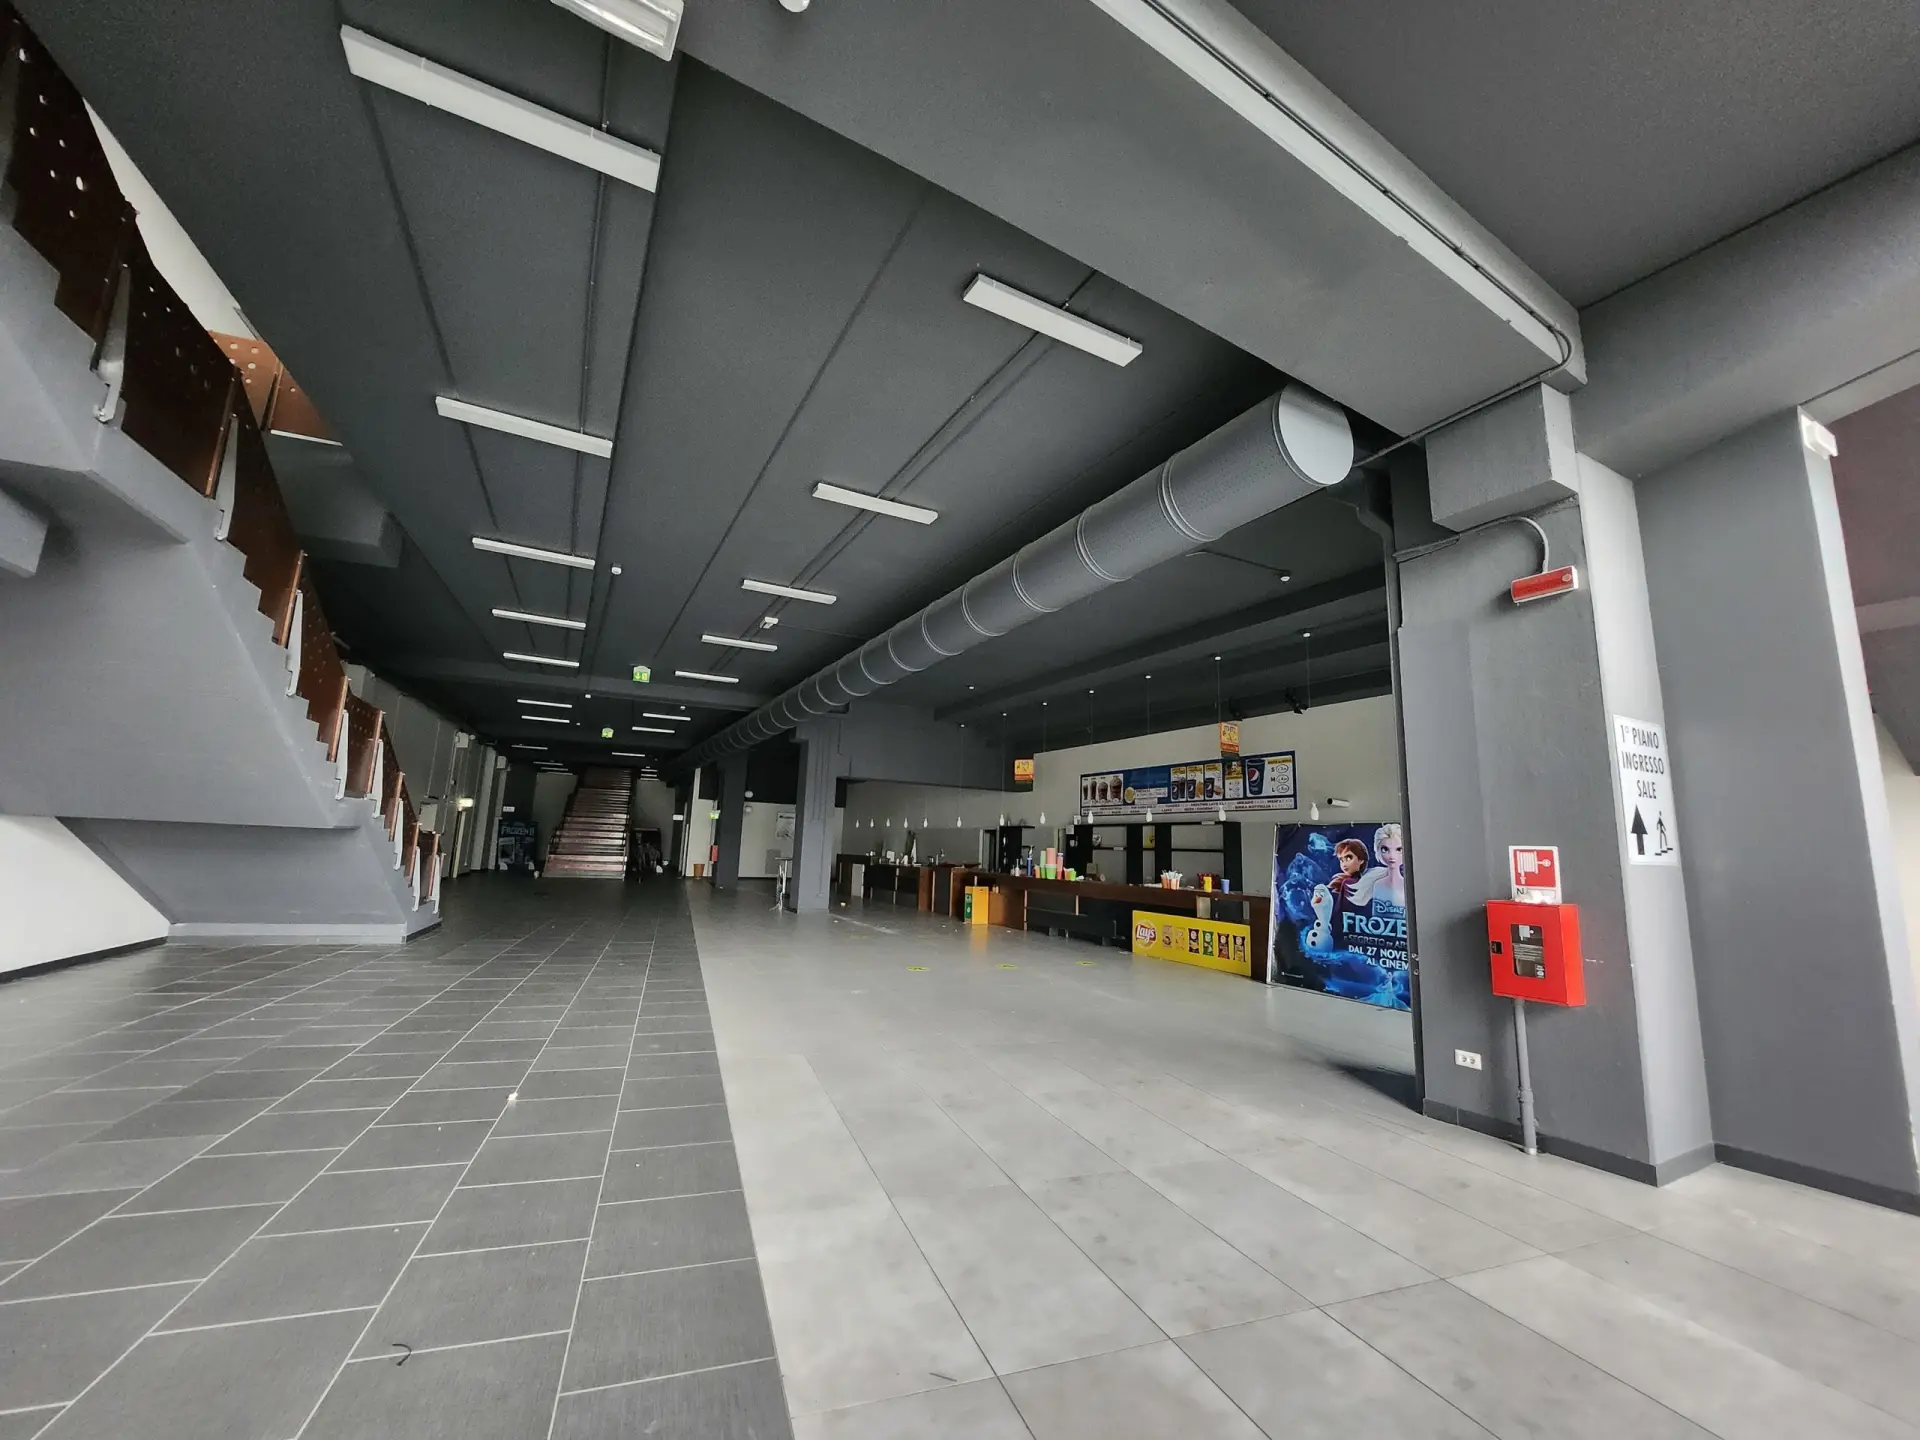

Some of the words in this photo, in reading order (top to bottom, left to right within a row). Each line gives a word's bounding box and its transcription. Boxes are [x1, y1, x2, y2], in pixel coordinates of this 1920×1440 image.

[1632, 727, 1659, 749] PIANO
[1621, 750, 1665, 775] INGRESSO
[1636, 779, 1657, 800] SALE
[1348, 934, 1385, 947] SEGRETO
[1348, 945, 1364, 955] DAL
[1366, 946, 1377, 956] 27
[1366, 957, 1378, 966] AL
